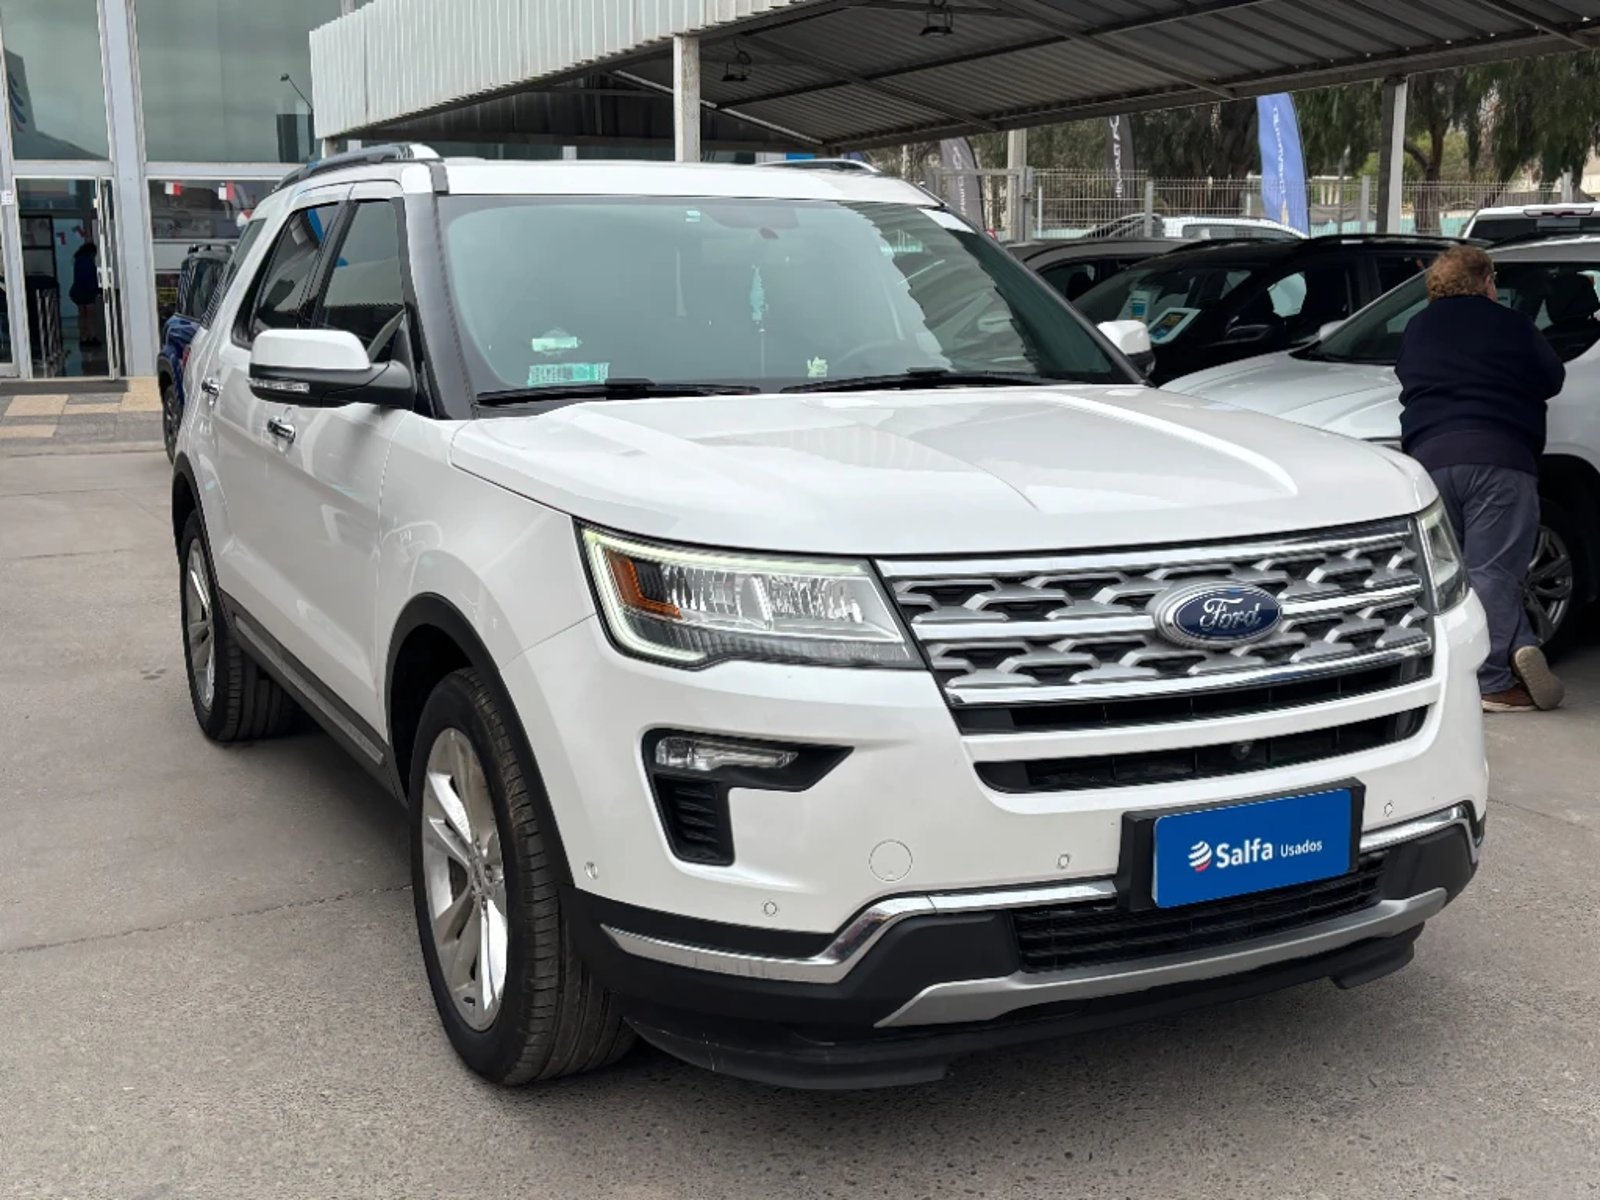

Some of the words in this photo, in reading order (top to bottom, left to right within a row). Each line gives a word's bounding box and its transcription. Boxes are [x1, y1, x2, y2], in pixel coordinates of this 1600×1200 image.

[1199, 597, 1262, 632] Ford
[1215, 837, 1274, 869] Salfa
[1280, 839, 1323, 858] Usados
